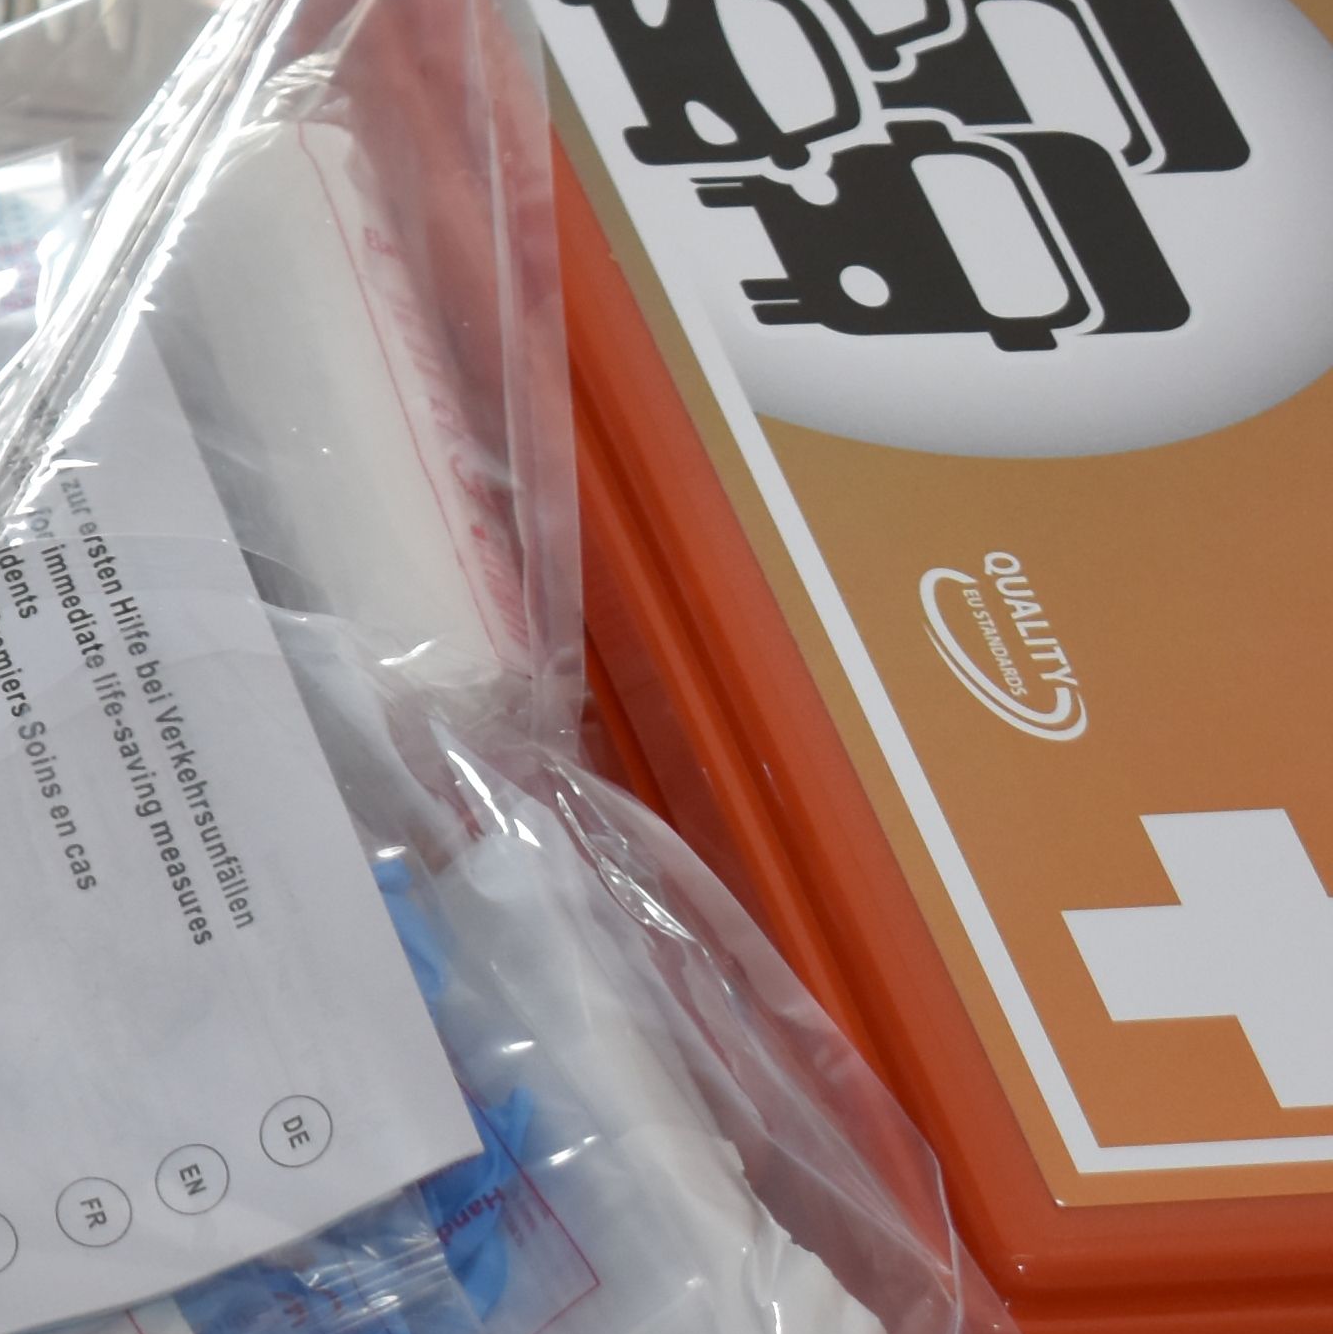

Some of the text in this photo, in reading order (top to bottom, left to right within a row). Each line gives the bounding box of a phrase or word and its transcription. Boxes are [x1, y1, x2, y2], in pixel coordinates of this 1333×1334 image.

[963, 588, 1026, 696] EU STANDARDS
[985, 552, 1075, 694] QUALITY
[44, 545, 103, 667] immediate
[95, 674, 161, 817] life-saving
[152, 821, 211, 944] measures
[61, 479, 252, 926] zur ersten Hilfe bei Verkehrsunfällen
[19, 721, 61, 798] Soins
[50, 805, 77, 837] en
[65, 843, 97, 890] cas
[179, 1164, 206, 1196] EN
[283, 1116, 310, 1149] DE
[80, 1198, 107, 1229] FR
